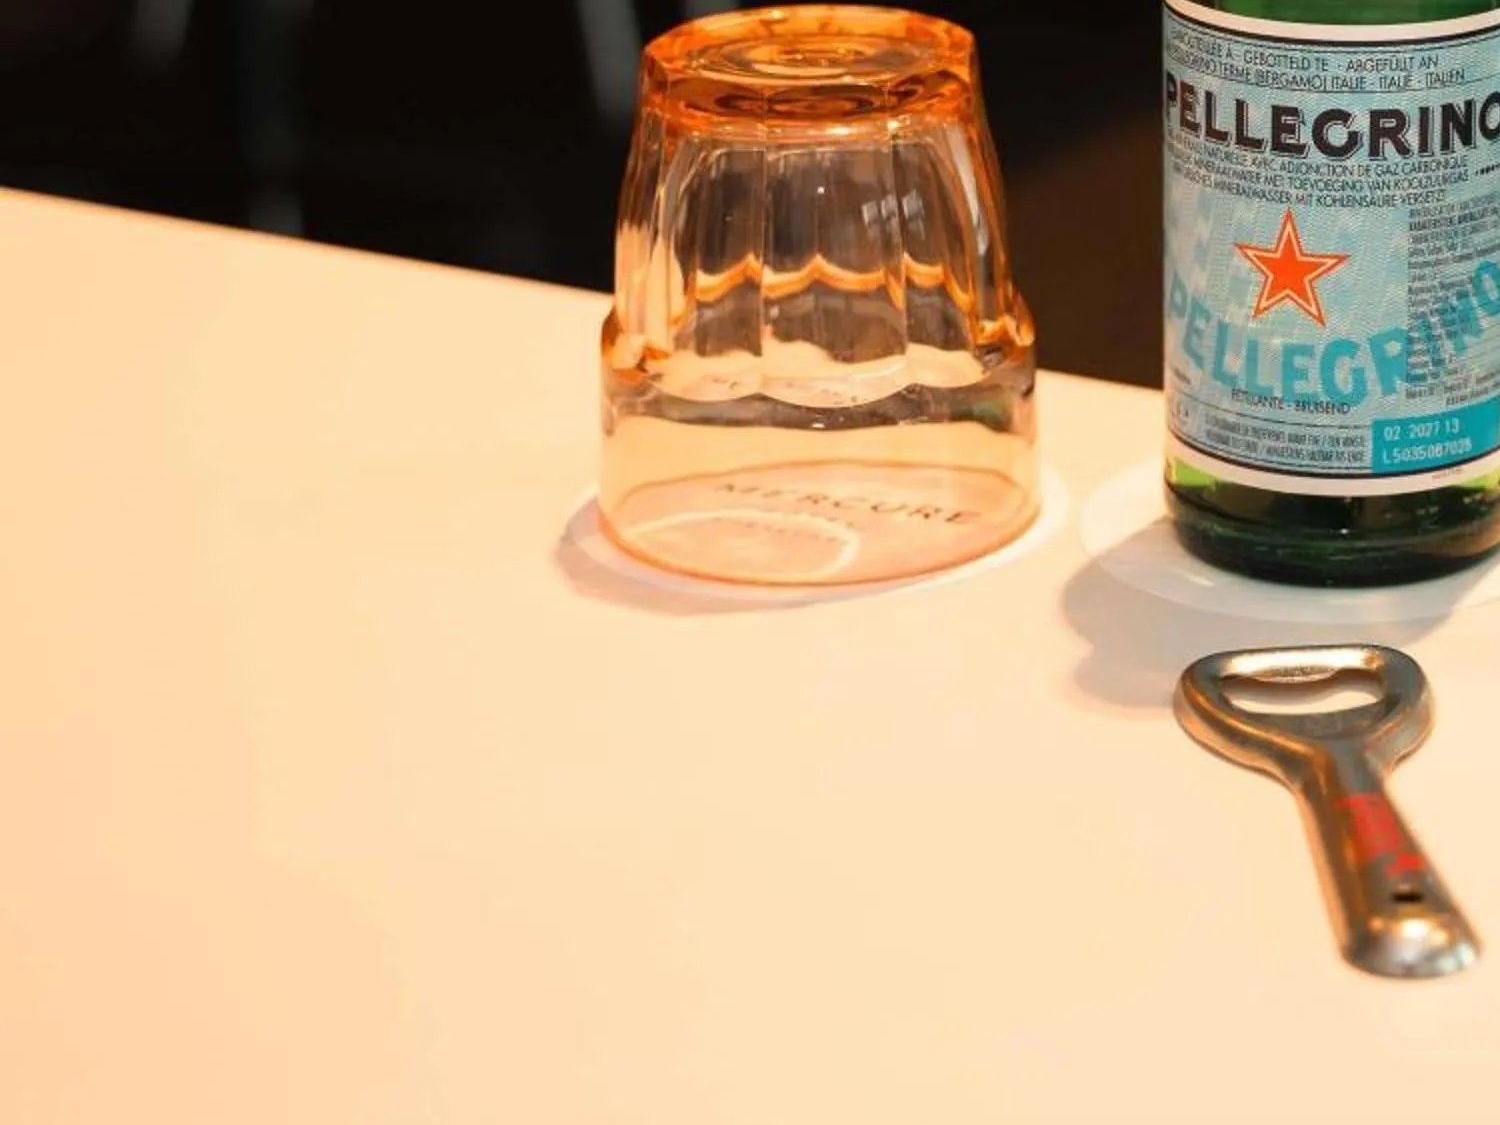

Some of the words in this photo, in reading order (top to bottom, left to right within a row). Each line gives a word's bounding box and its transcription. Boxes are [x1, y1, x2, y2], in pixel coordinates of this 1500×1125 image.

[1315, 58, 1330, 72] TE
[1417, 54, 1439, 69] AN
[1374, 161, 1399, 176] GAZ
[1383, 425, 1400, 442] 02
[1409, 421, 1441, 439] 2027
